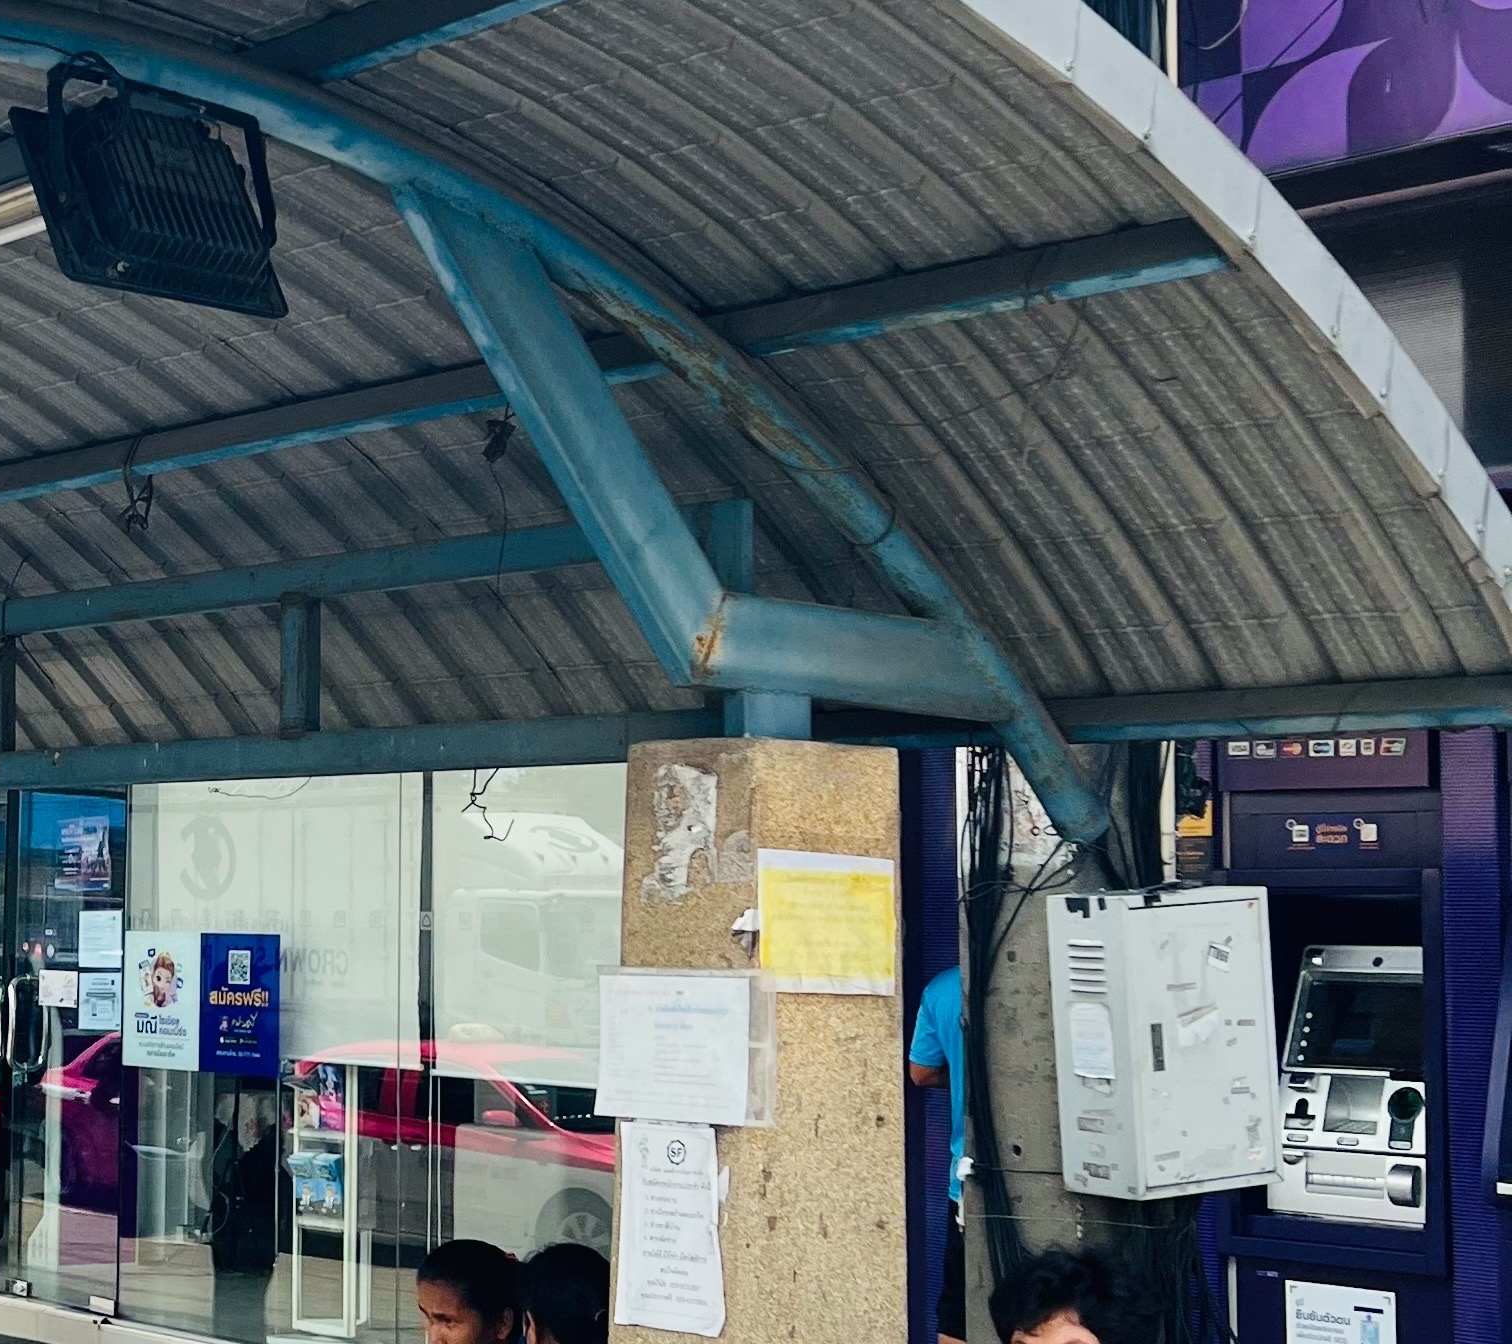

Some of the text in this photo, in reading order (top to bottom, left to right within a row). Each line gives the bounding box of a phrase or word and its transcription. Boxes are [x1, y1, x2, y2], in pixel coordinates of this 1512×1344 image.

[209, 986, 269, 1008] สมัครฟรี!!
[136, 1015, 157, 1034] มณี
[670, 1147, 683, 1158] SF
